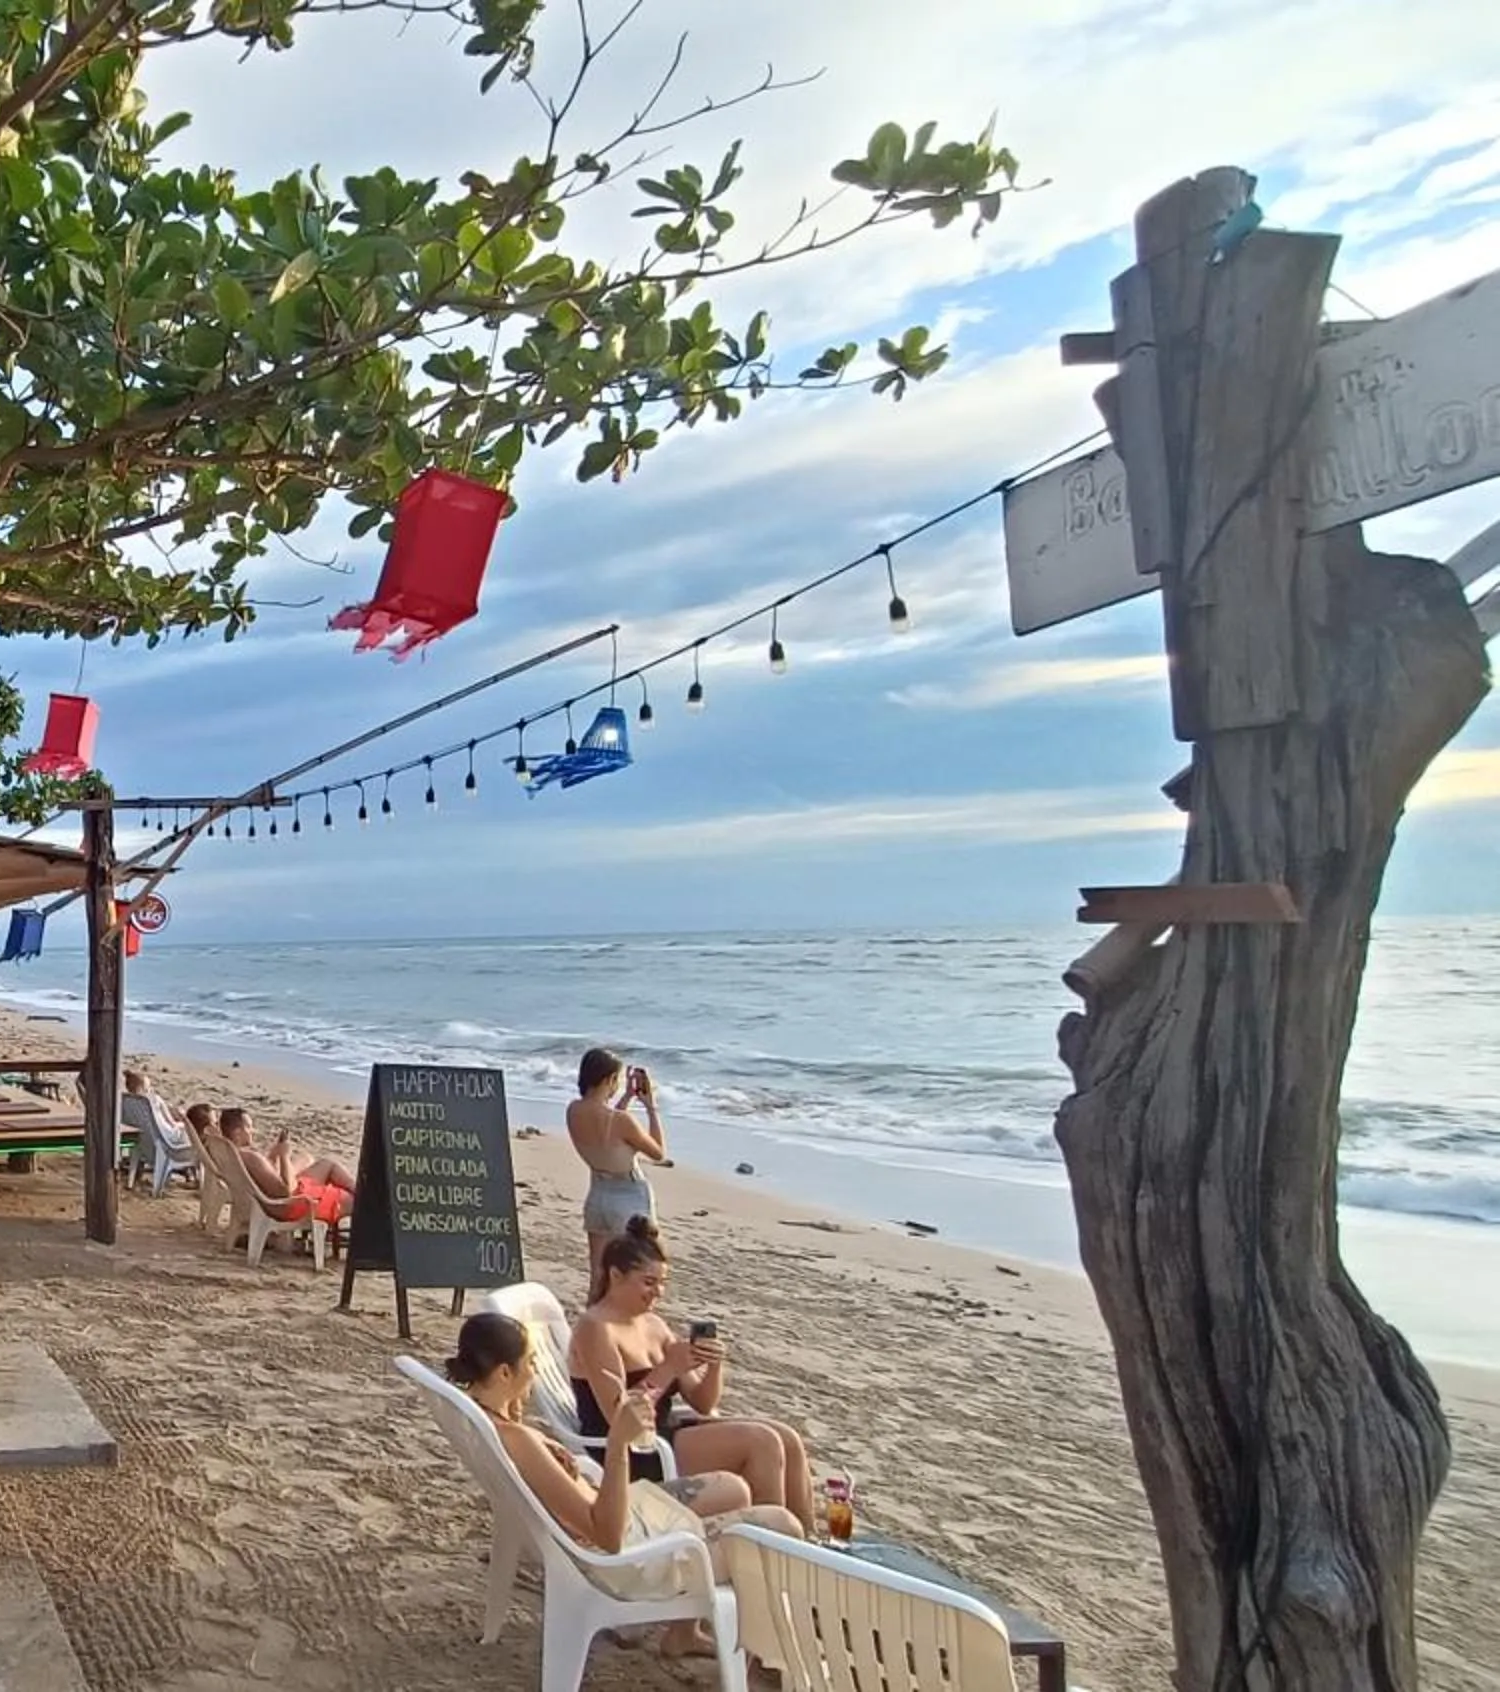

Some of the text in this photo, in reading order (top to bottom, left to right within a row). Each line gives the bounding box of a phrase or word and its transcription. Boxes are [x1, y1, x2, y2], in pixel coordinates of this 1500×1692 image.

[393, 1071, 497, 1098] HAPPY HOUR
[389, 1103, 445, 1121] MOJITO
[432, 1157, 488, 1178] COLADA
[396, 1184, 484, 1207] CUBA LIBRE
[477, 1239, 508, 1275] 100
